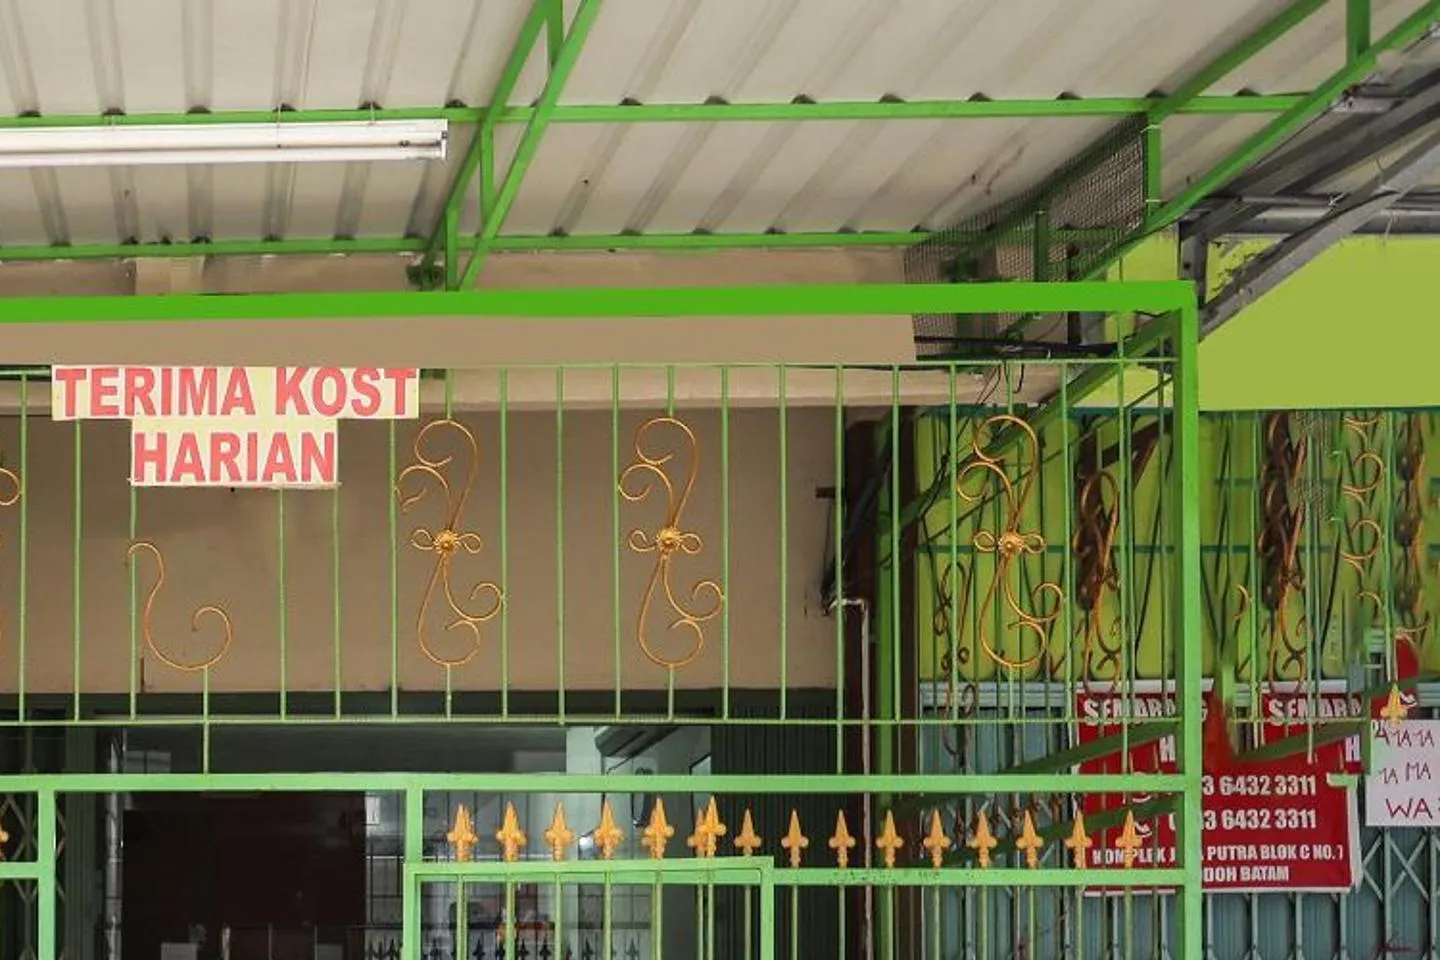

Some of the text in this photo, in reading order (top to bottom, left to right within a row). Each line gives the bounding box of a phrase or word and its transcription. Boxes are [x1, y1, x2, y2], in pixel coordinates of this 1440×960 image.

[56, 367, 417, 417] TERIMA KOST
[134, 431, 335, 483] HARIAN
[1219, 774, 1271, 796] 6432
[1274, 774, 1317, 796] 3311
[1221, 809, 1271, 831] 6432
[1275, 808, 1317, 830] 3311
[1207, 845, 1258, 861] PUTRA
[1260, 844, 1297, 861] BLOK
[1299, 844, 1310, 860] C
[1203, 865, 1289, 882] DOH BATAM
